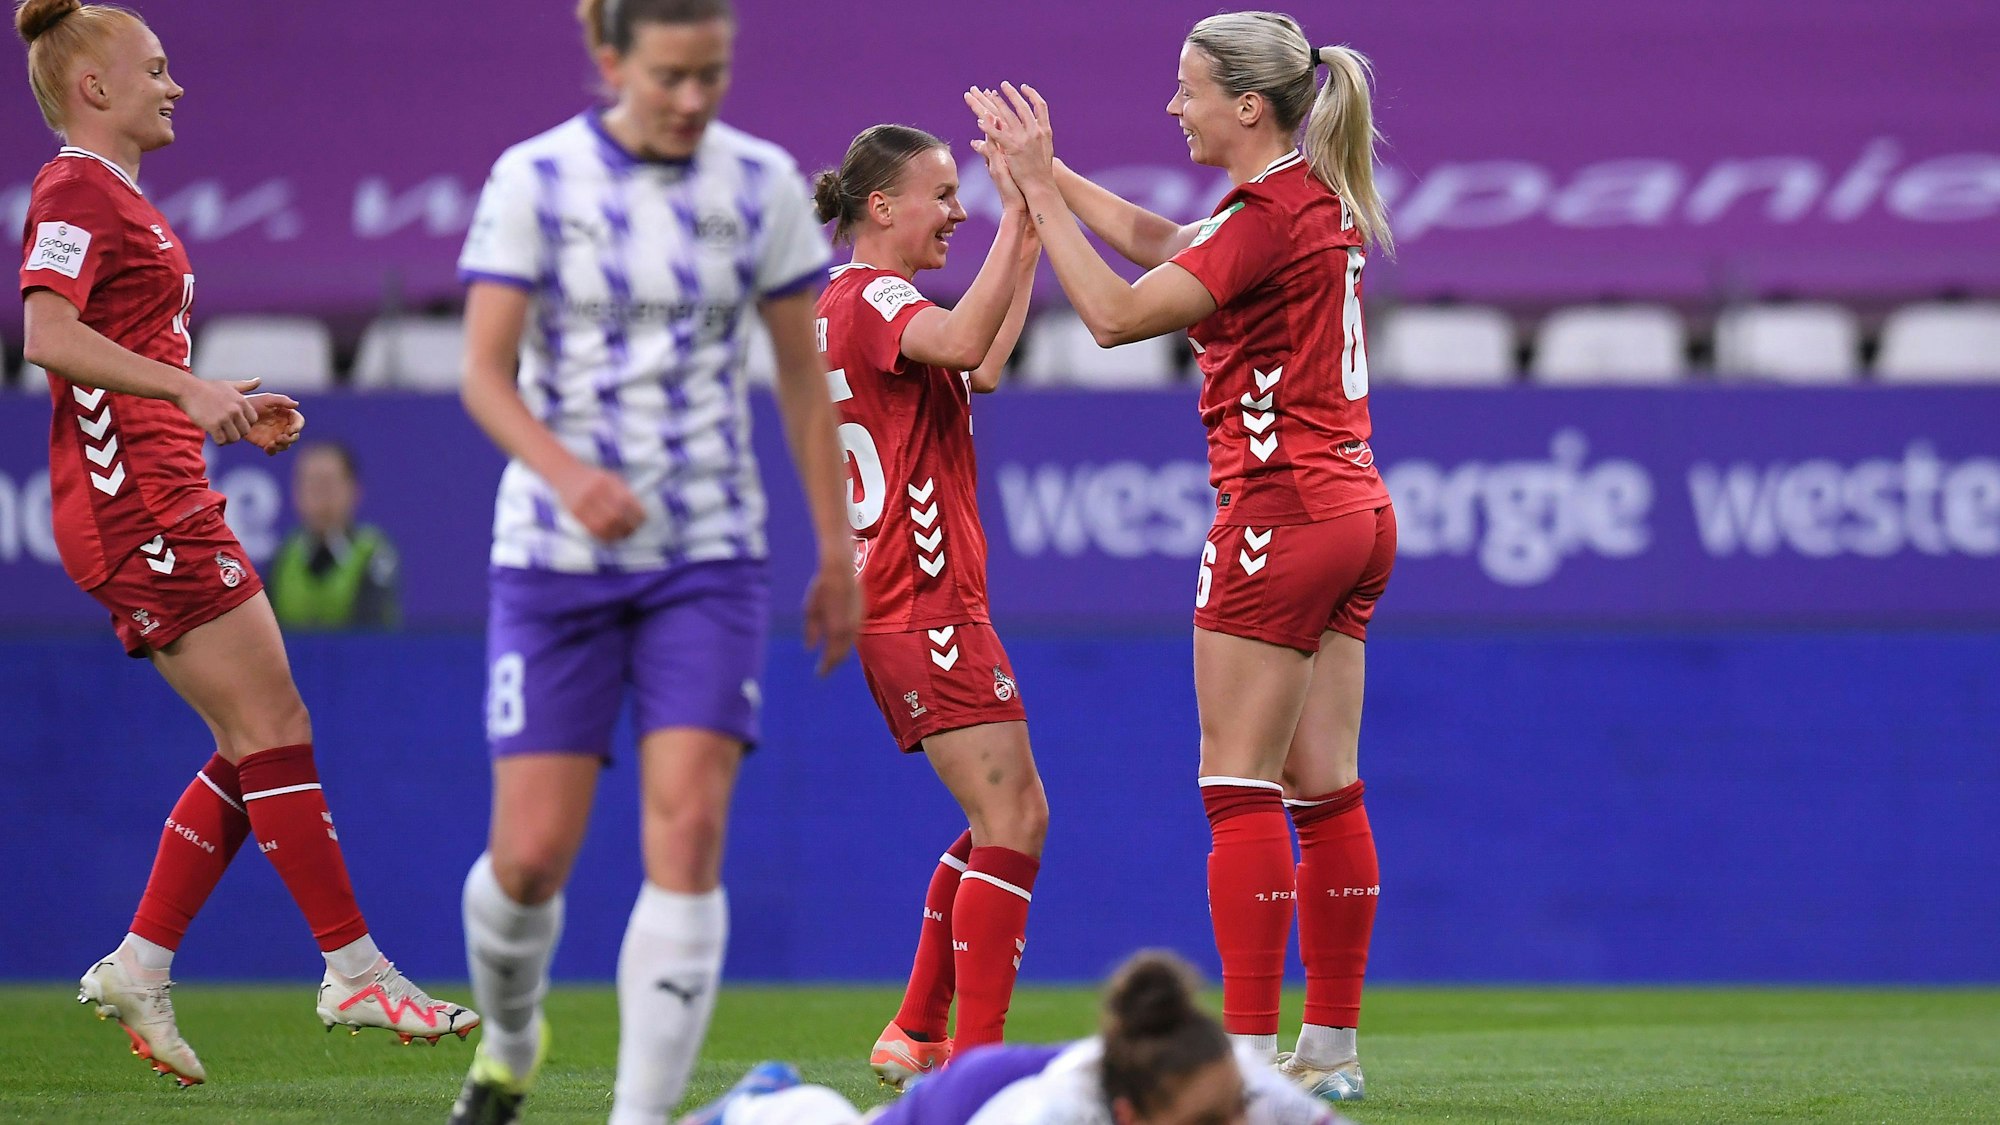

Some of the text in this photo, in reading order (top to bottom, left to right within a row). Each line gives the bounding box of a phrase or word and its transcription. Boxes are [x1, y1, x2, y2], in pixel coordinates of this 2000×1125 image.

[39, 237, 81, 255] Google
[41, 249, 70, 264] Pixel
[873, 283, 909, 303] Goog
[1342, 246, 1369, 400] 6
[1196, 541, 1217, 608] 6
[487, 652, 526, 738] 8
[175, 823, 216, 854] KÖLN
[258, 840, 278, 853] LN
[1271, 891, 1290, 901] FC
[1343, 887, 1365, 897] FC
[1367, 884, 1380, 896] KÖ
[923, 906, 942, 921] LN
[953, 939, 968, 951] LN
